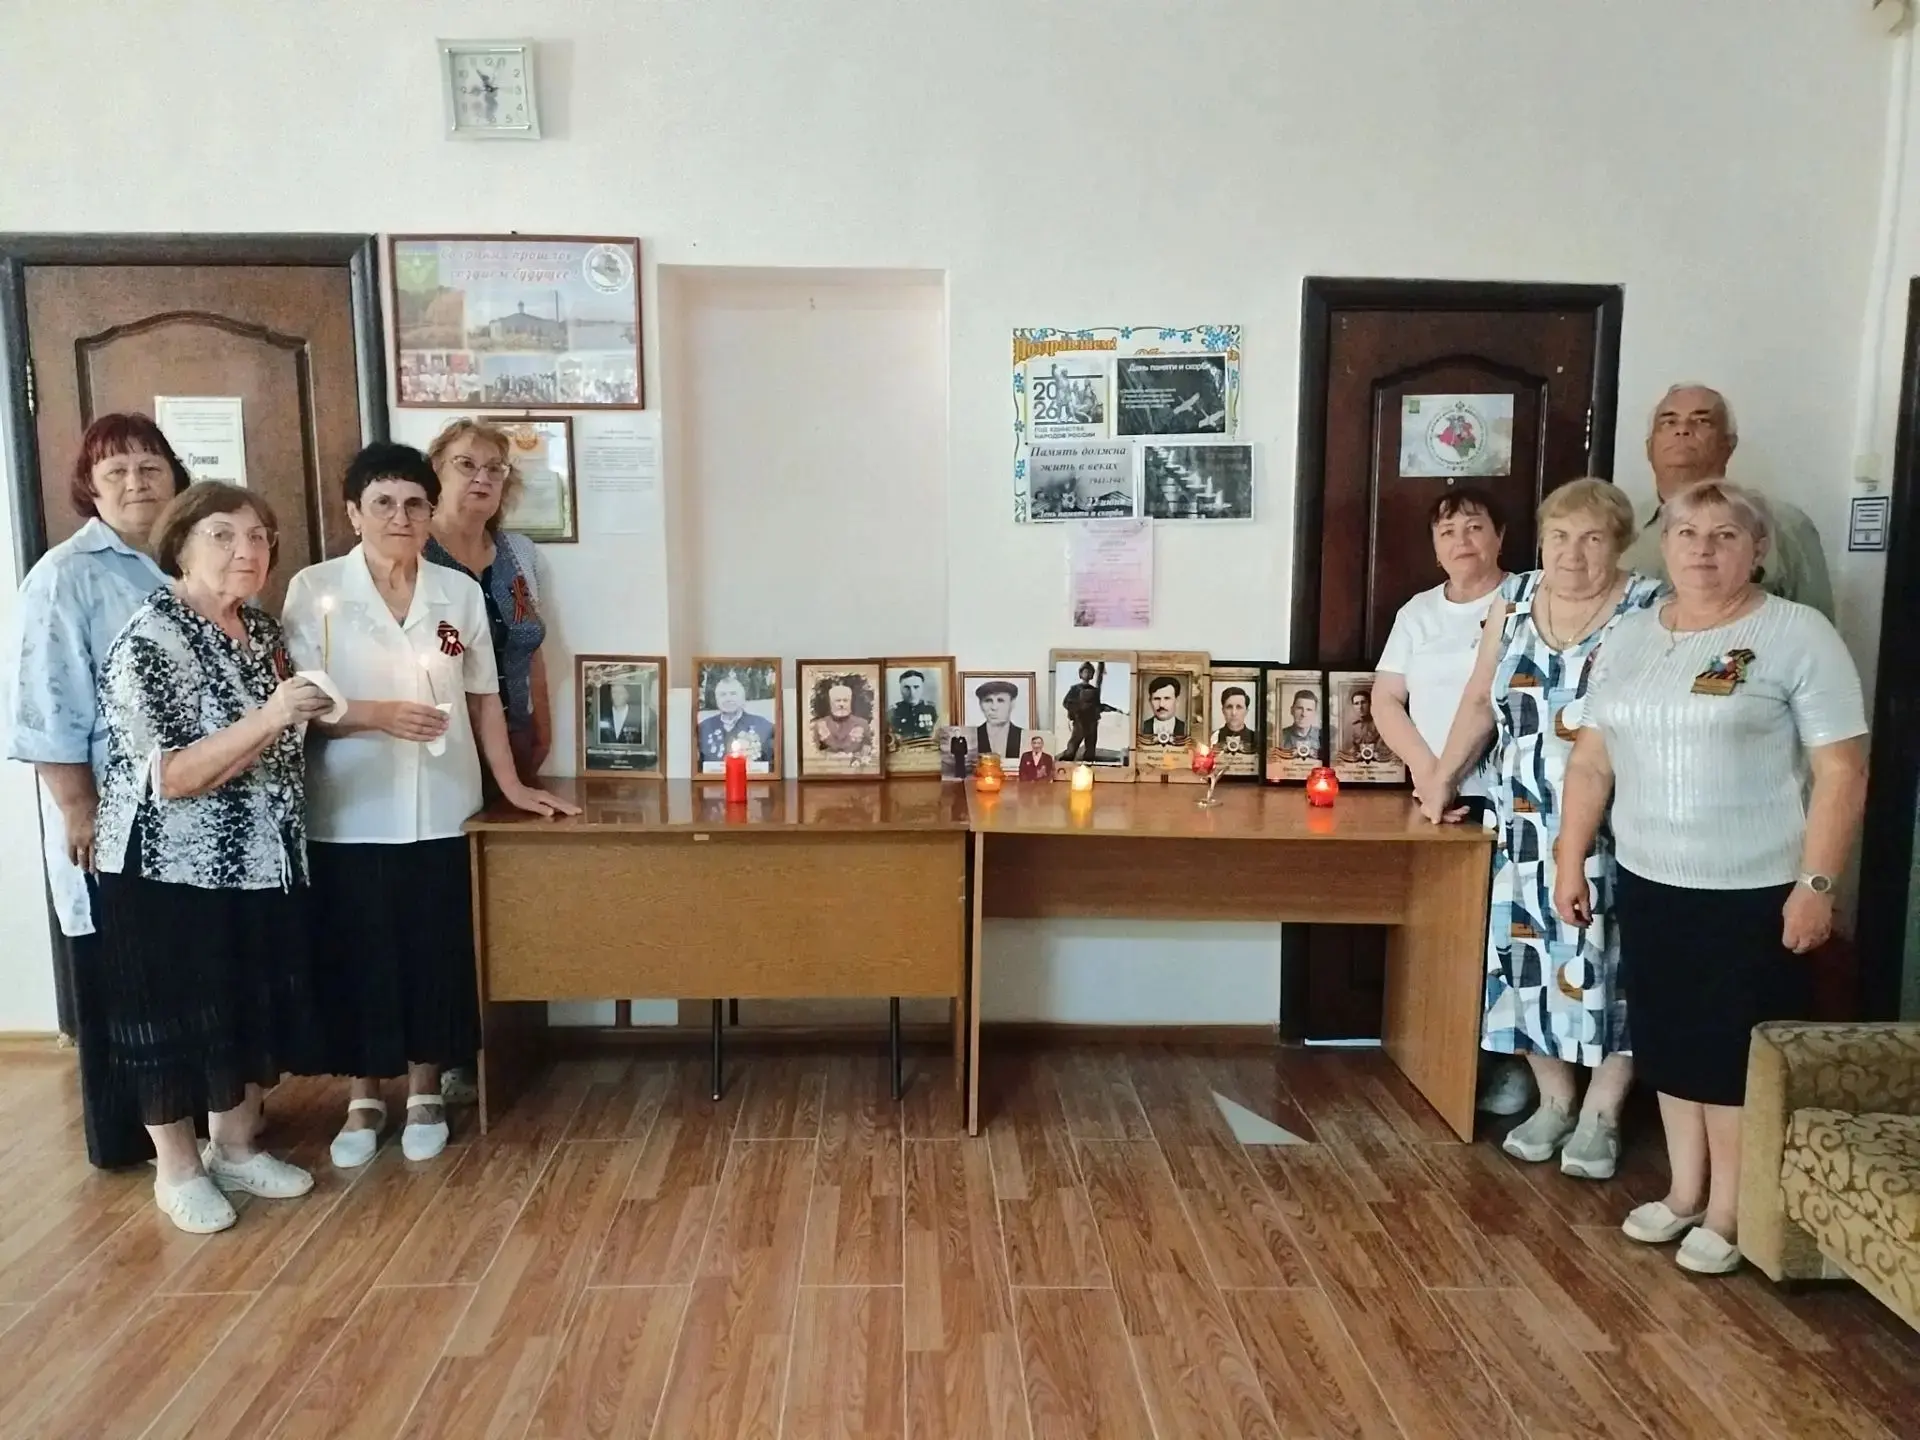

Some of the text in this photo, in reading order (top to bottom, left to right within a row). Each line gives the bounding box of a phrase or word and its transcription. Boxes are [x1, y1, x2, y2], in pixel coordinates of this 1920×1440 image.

[1128, 363, 1149, 372] День
[1033, 381, 1057, 401] 20
[1034, 401, 1058, 420] 26
[1030, 446, 1126, 457] Память должна
[188, 452, 219, 467] Громова
[1040, 463, 1076, 472] жить
[1087, 462, 1119, 471] веках
